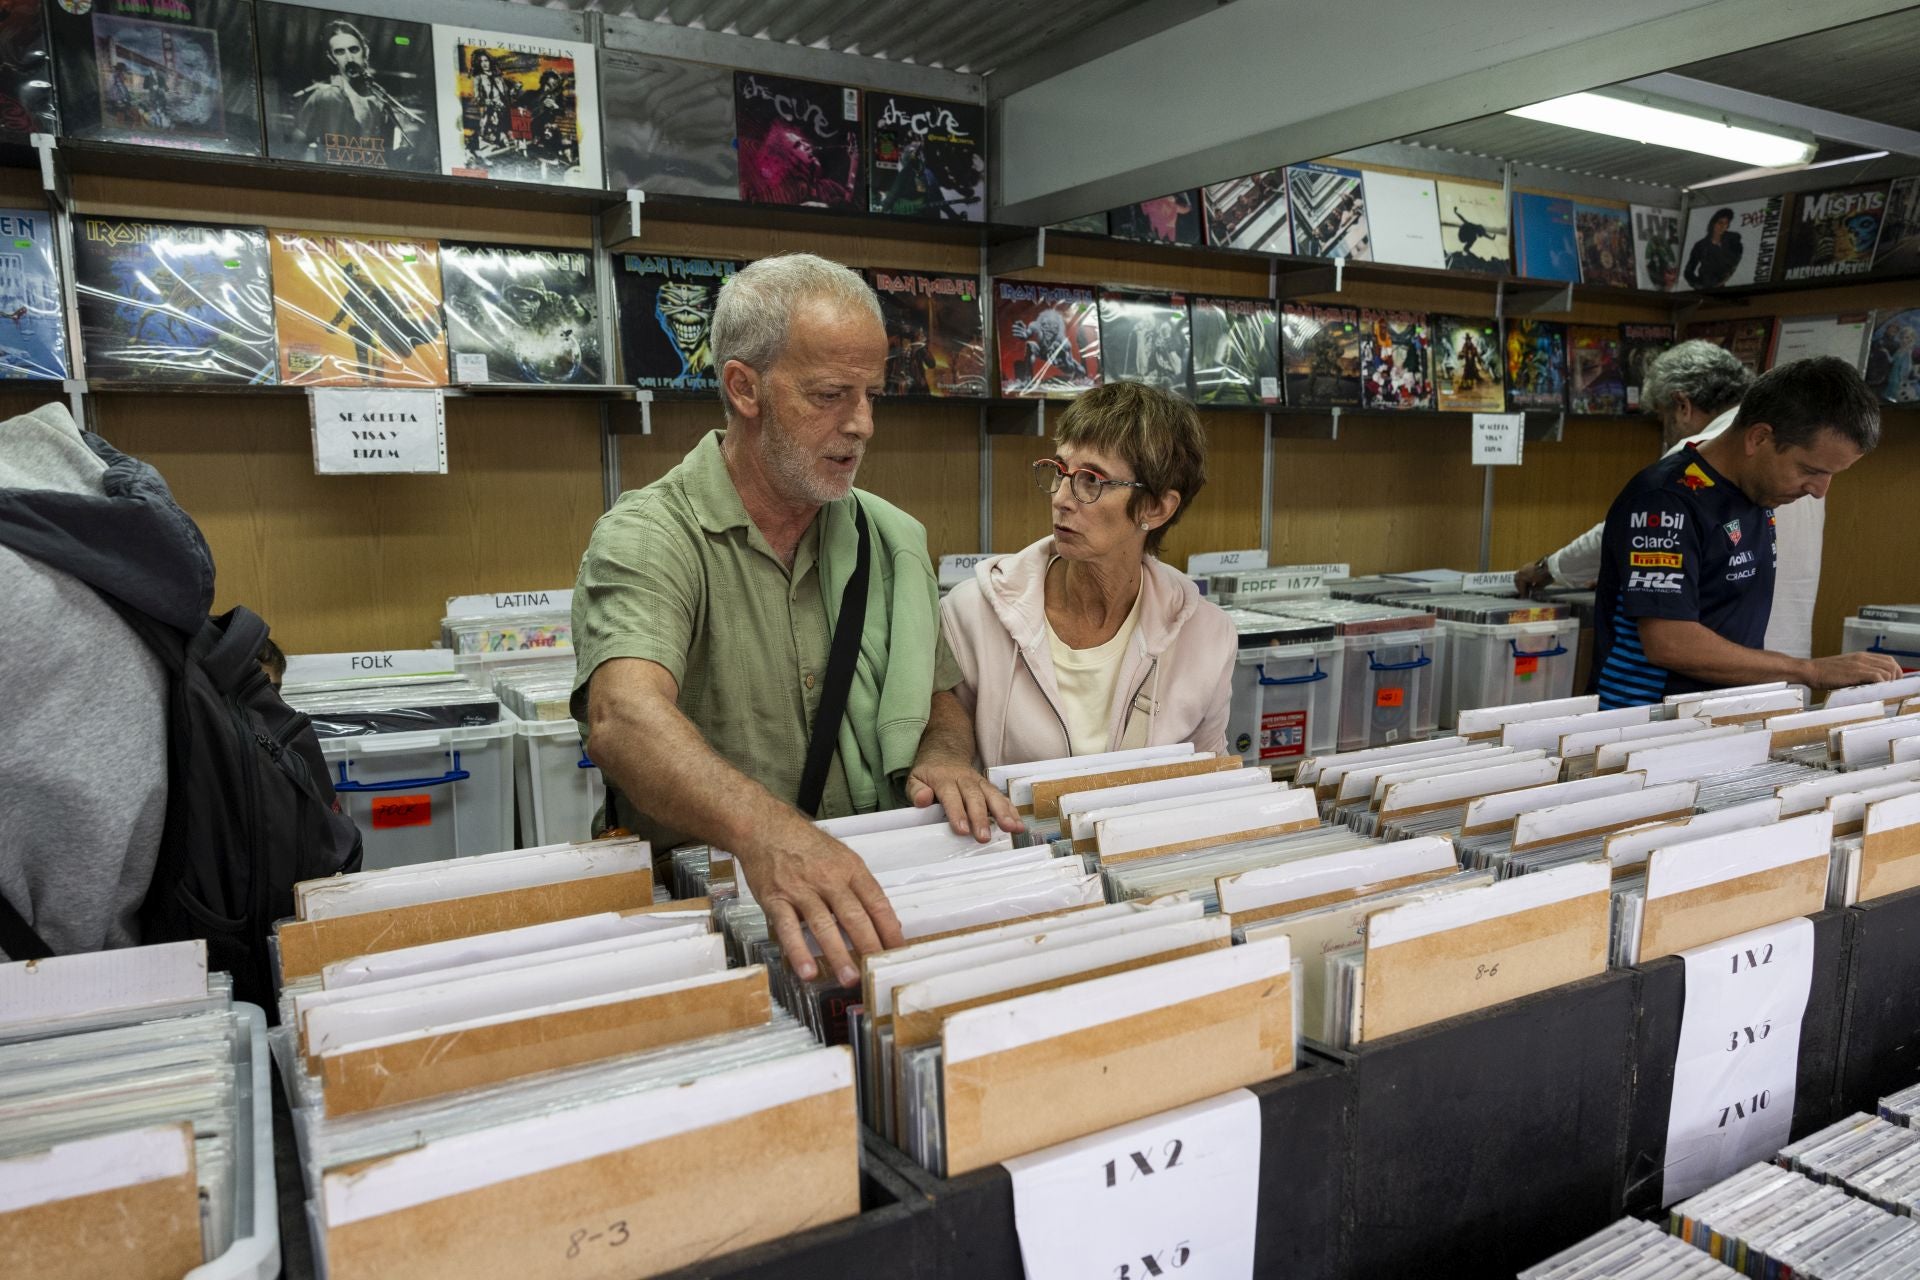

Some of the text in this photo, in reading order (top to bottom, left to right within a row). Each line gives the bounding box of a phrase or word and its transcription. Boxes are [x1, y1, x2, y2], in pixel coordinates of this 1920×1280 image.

[457, 36, 576, 58] LED ZEPPELIN
[86, 220, 151, 248] IRON
[1636, 212, 1680, 245] LIVE
[624, 254, 736, 280] IRON MAIDEN
[1785, 262, 1838, 280] AMERICAN
[876, 274, 977, 300] IRON MAIDEN
[1000, 283, 1093, 306] IRON MAIDEN
[339, 413, 418, 422] SE ACEPTA
[352, 431, 387, 440] VISA
[1630, 512, 1685, 530] Mobil
[1632, 536, 1674, 549] Claro
[955, 557, 978, 568] POP
[1220, 554, 1240, 565] JAZZ
[1473, 573, 1514, 585] HEAVY ME
[1628, 571, 1685, 589] HRC
[495, 592, 550, 609] LATINA
[1862, 609, 1899, 619] DEFTONES
[351, 654, 394, 670] FOLK
[1475, 963, 1500, 981] 8-6
[566, 1220, 630, 1259] 8-3
